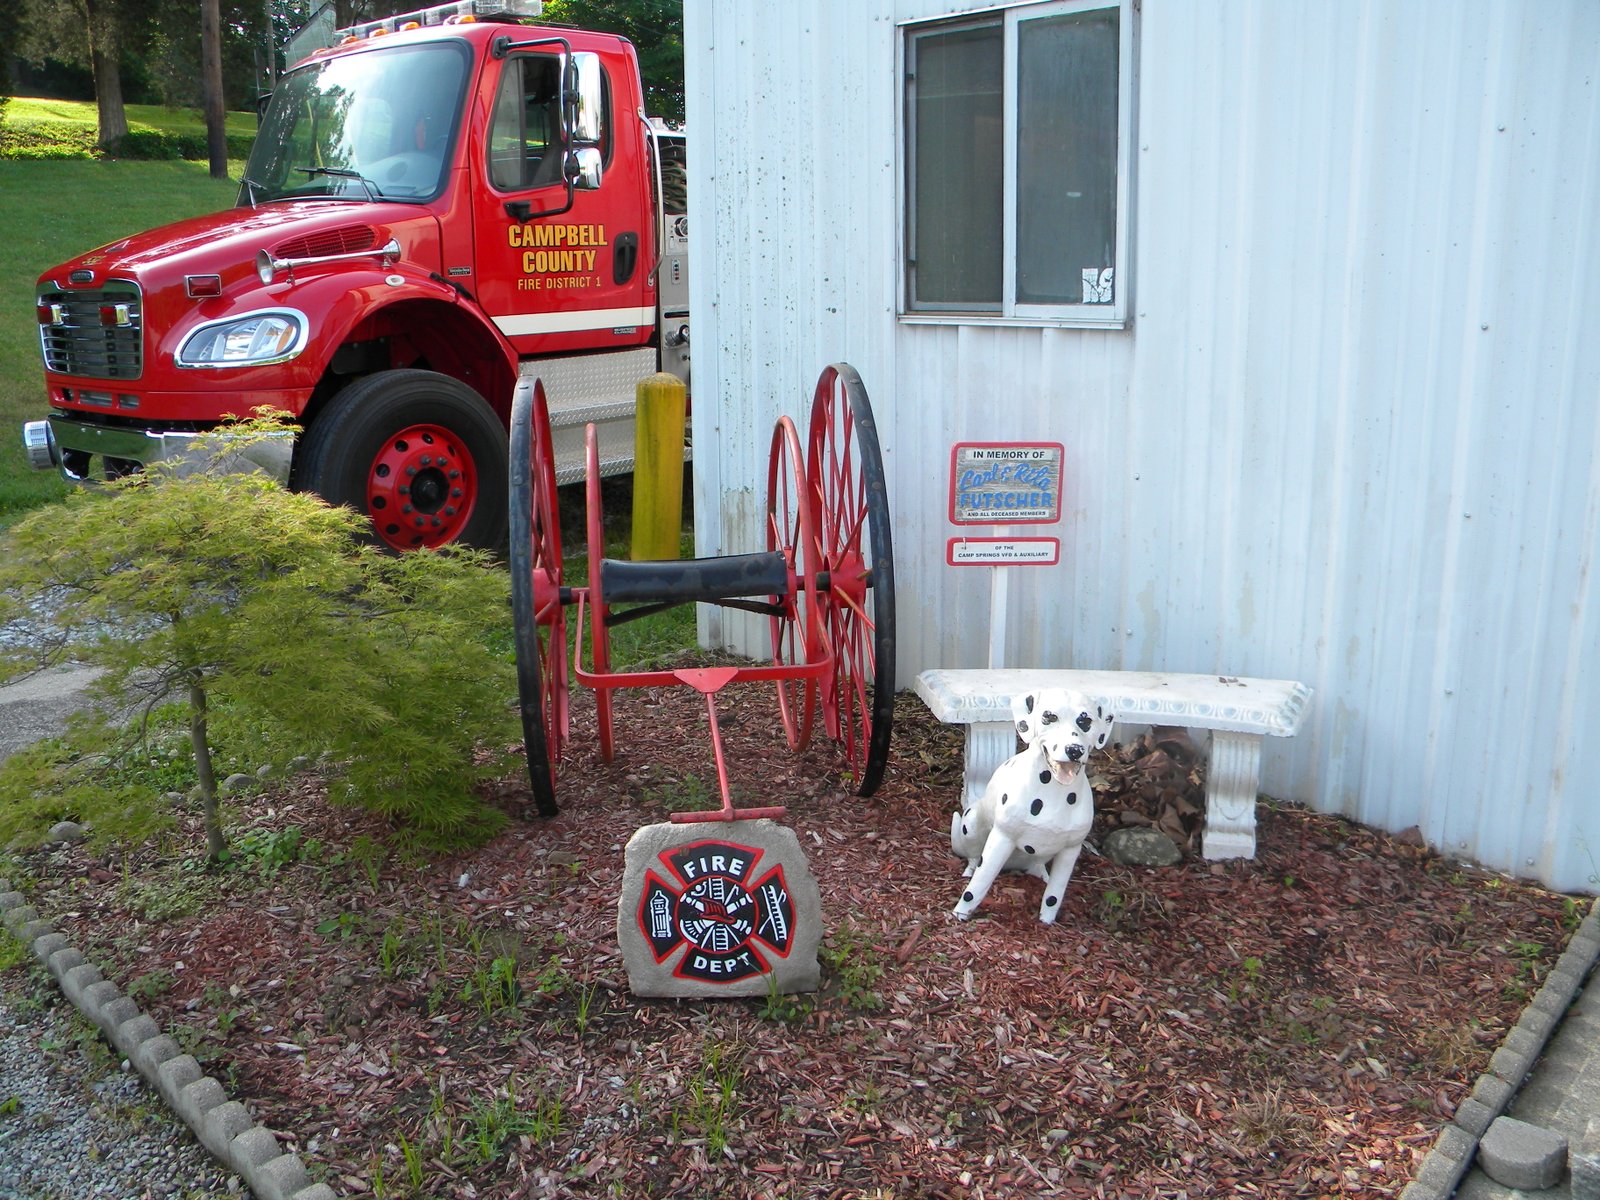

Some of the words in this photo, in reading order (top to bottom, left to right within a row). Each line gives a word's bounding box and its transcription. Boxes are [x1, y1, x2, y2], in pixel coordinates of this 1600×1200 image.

[508, 224, 608, 248] CAMPBELL
[522, 250, 597, 274] COUNTY
[517, 278, 541, 290] FIRE
[546, 276, 591, 289] DISTRICT
[596, 276, 601, 287] 1
[973, 451, 983, 459] IN
[986, 451, 1030, 459] MEMORY
[1032, 451, 1045, 459] OF
[960, 492, 1053, 509] FUTSCHER
[683, 855, 744, 878] FIRE
[693, 952, 752, 973] DEPT
